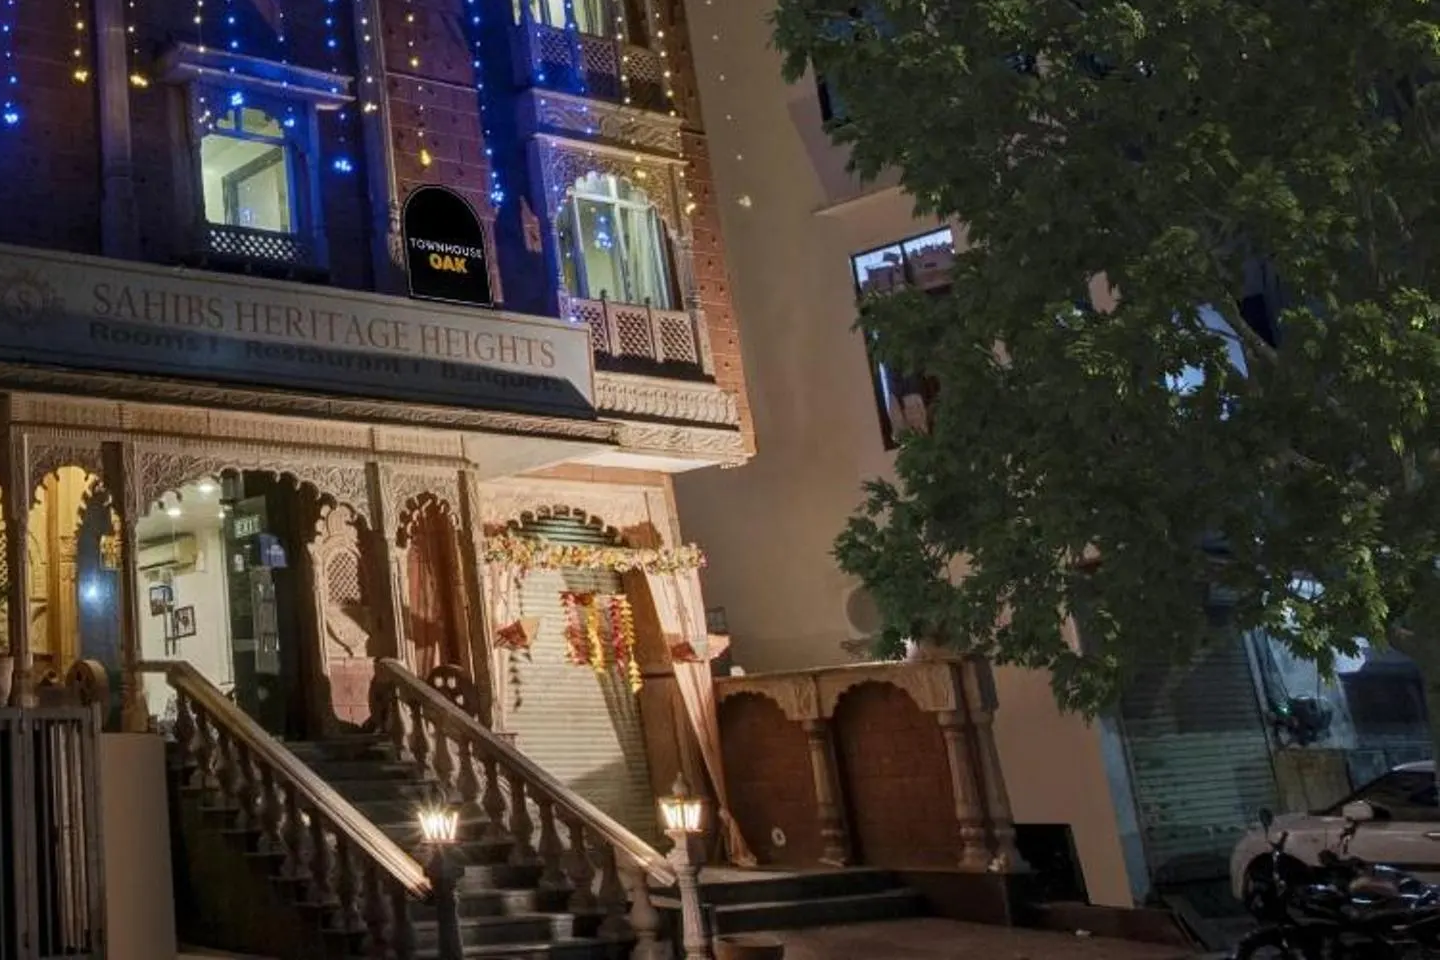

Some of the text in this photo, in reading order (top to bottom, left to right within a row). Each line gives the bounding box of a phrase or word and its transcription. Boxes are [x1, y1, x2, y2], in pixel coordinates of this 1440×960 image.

[409, 237, 482, 259] TOWNHOUSE
[429, 252, 468, 274] OAK
[93, 283, 556, 369] SAHIBS HERITAGE HEIGHTS
